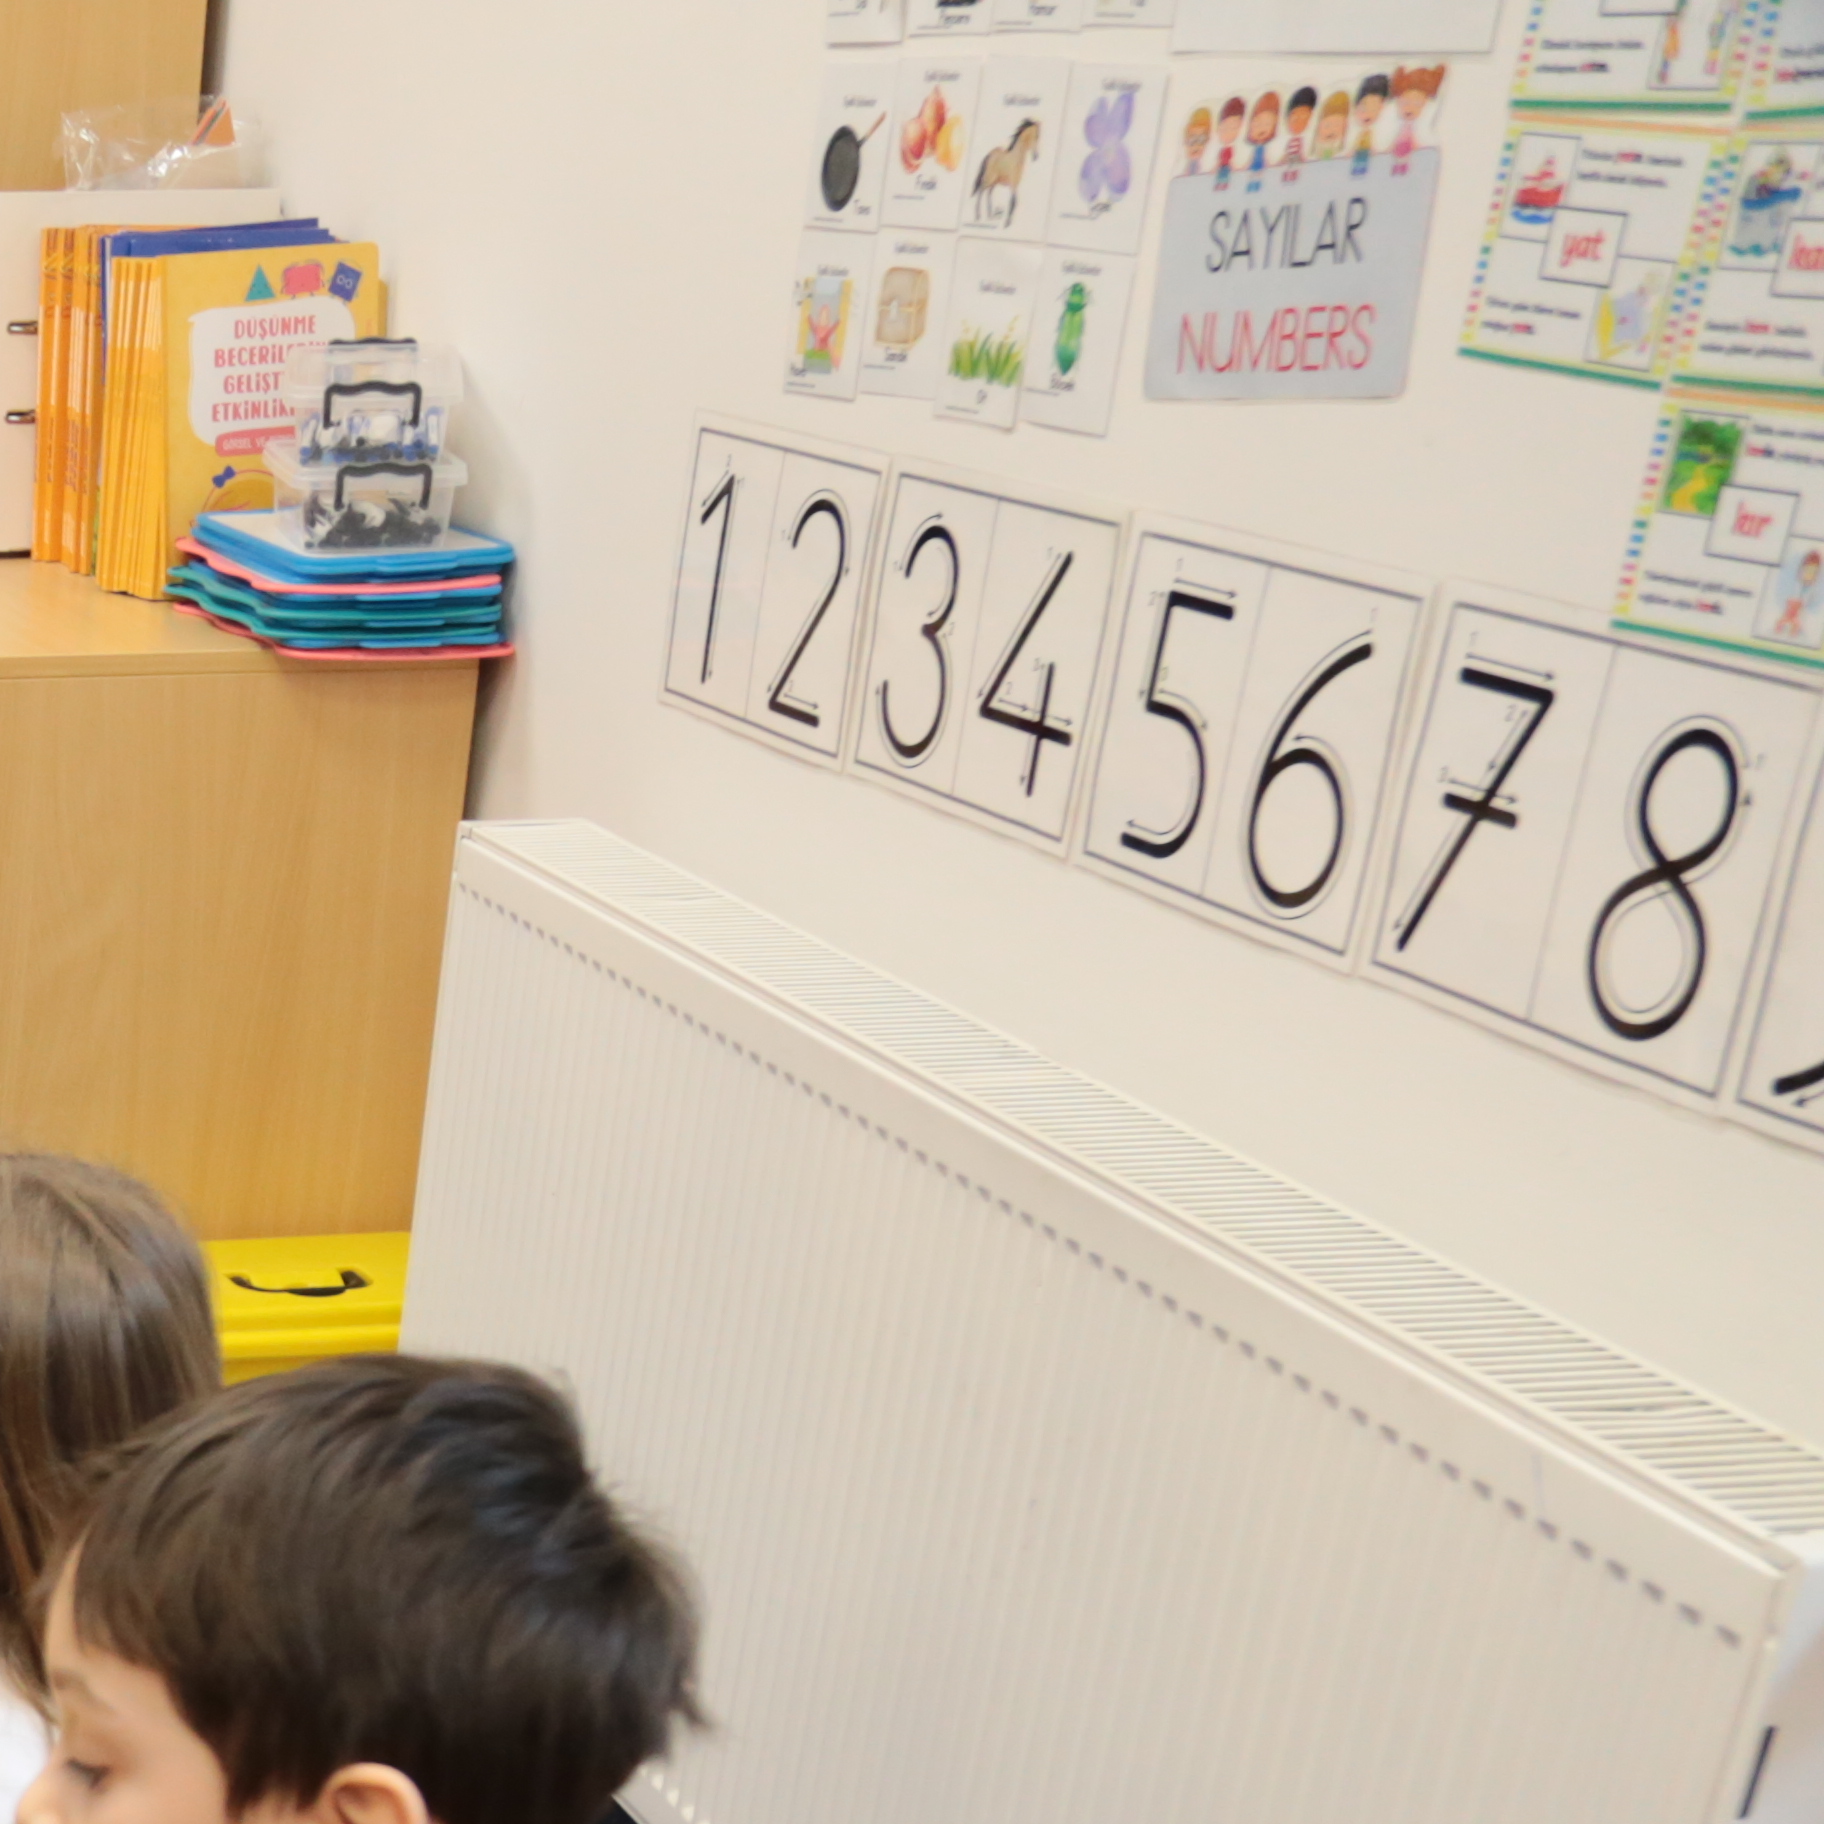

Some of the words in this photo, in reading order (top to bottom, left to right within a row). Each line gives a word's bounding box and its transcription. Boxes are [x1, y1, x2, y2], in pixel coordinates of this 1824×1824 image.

[1204, 196, 1369, 274] SAYILAR
[1559, 229, 1608, 270] yat
[234, 314, 317, 340] DÜŞÜNME
[1176, 302, 1379, 375] NUMBERS
[223, 371, 284, 395] GELİŞT
[700, 473, 736, 685] 1
[768, 497, 846, 728] 2
[881, 525, 960, 759] 3
[979, 550, 1074, 797] 4
[1120, 590, 1235, 859] 5
[1249, 642, 1375, 909] 6
[1395, 666, 1555, 953] 7
[1588, 727, 1740, 1042] 8
